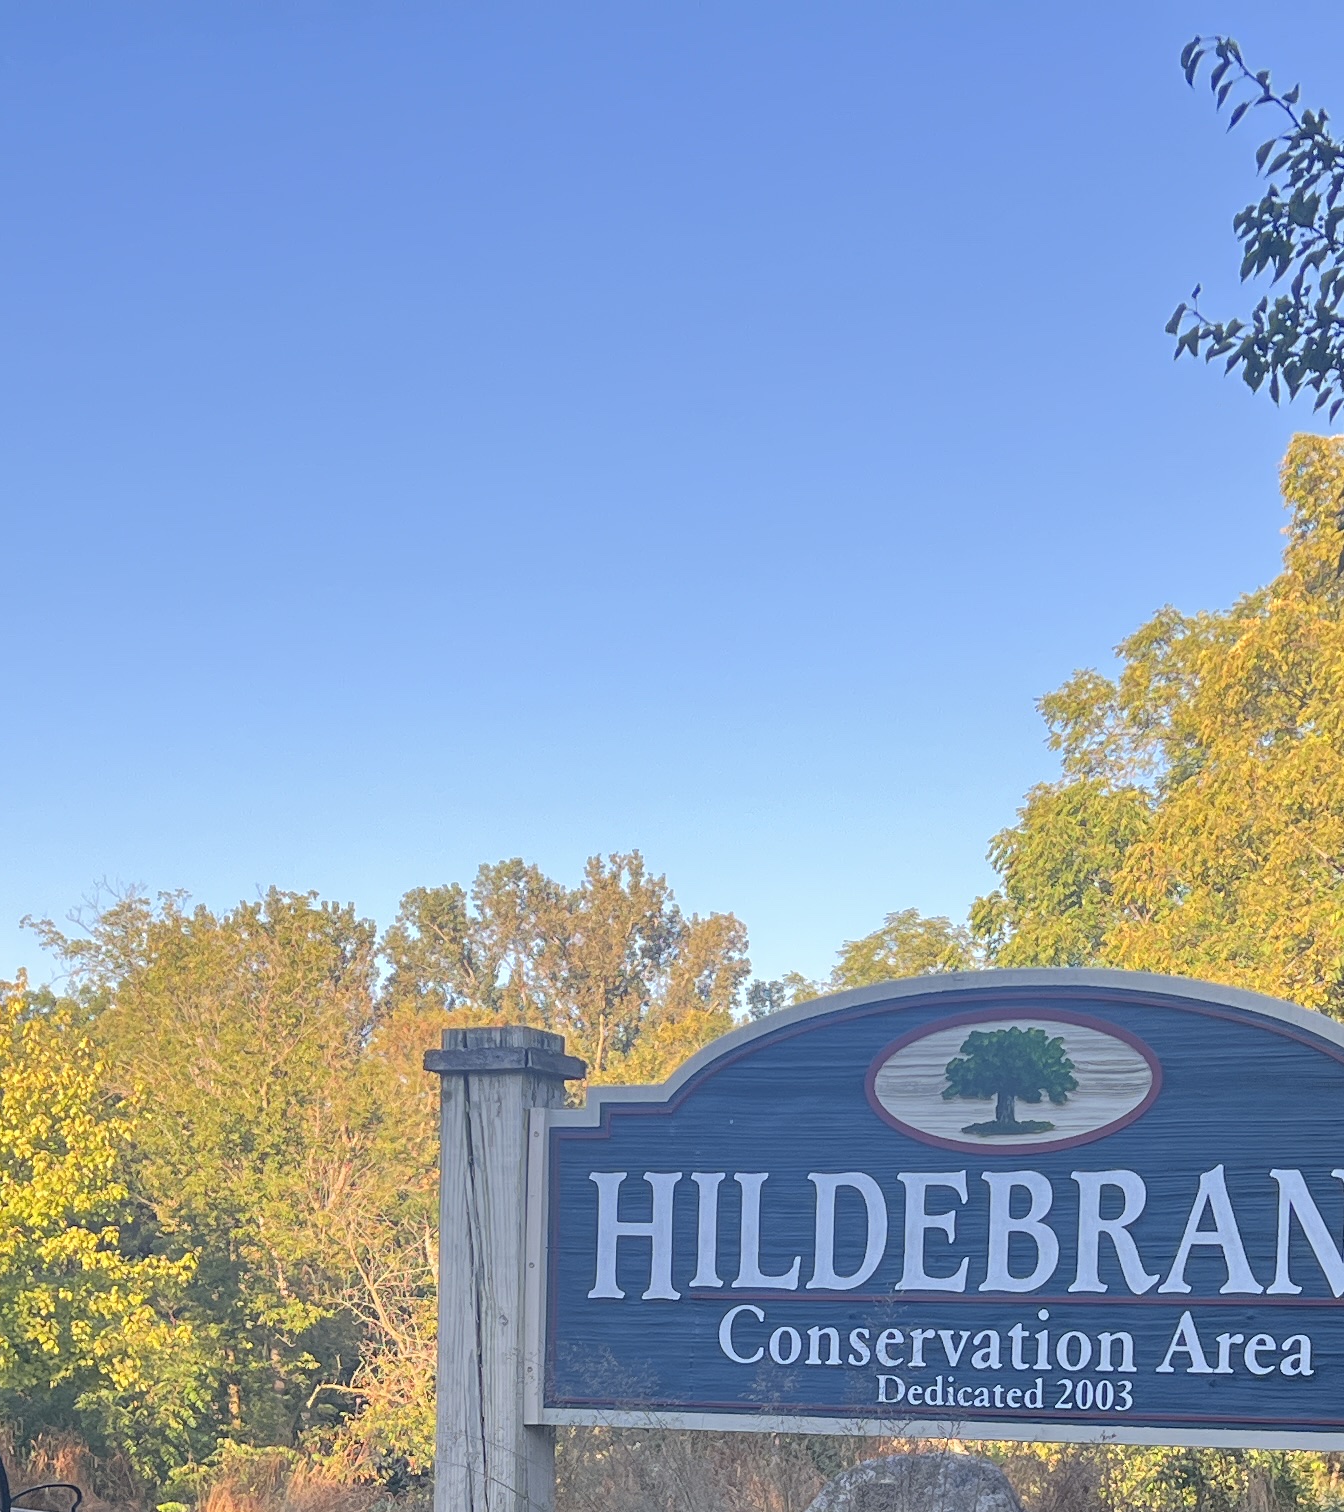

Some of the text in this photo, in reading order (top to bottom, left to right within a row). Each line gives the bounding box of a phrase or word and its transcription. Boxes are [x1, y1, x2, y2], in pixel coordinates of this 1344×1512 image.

[718, 1304, 1315, 1377] Conservation Area
[876, 1375, 1134, 1411] Dedicated 2003
